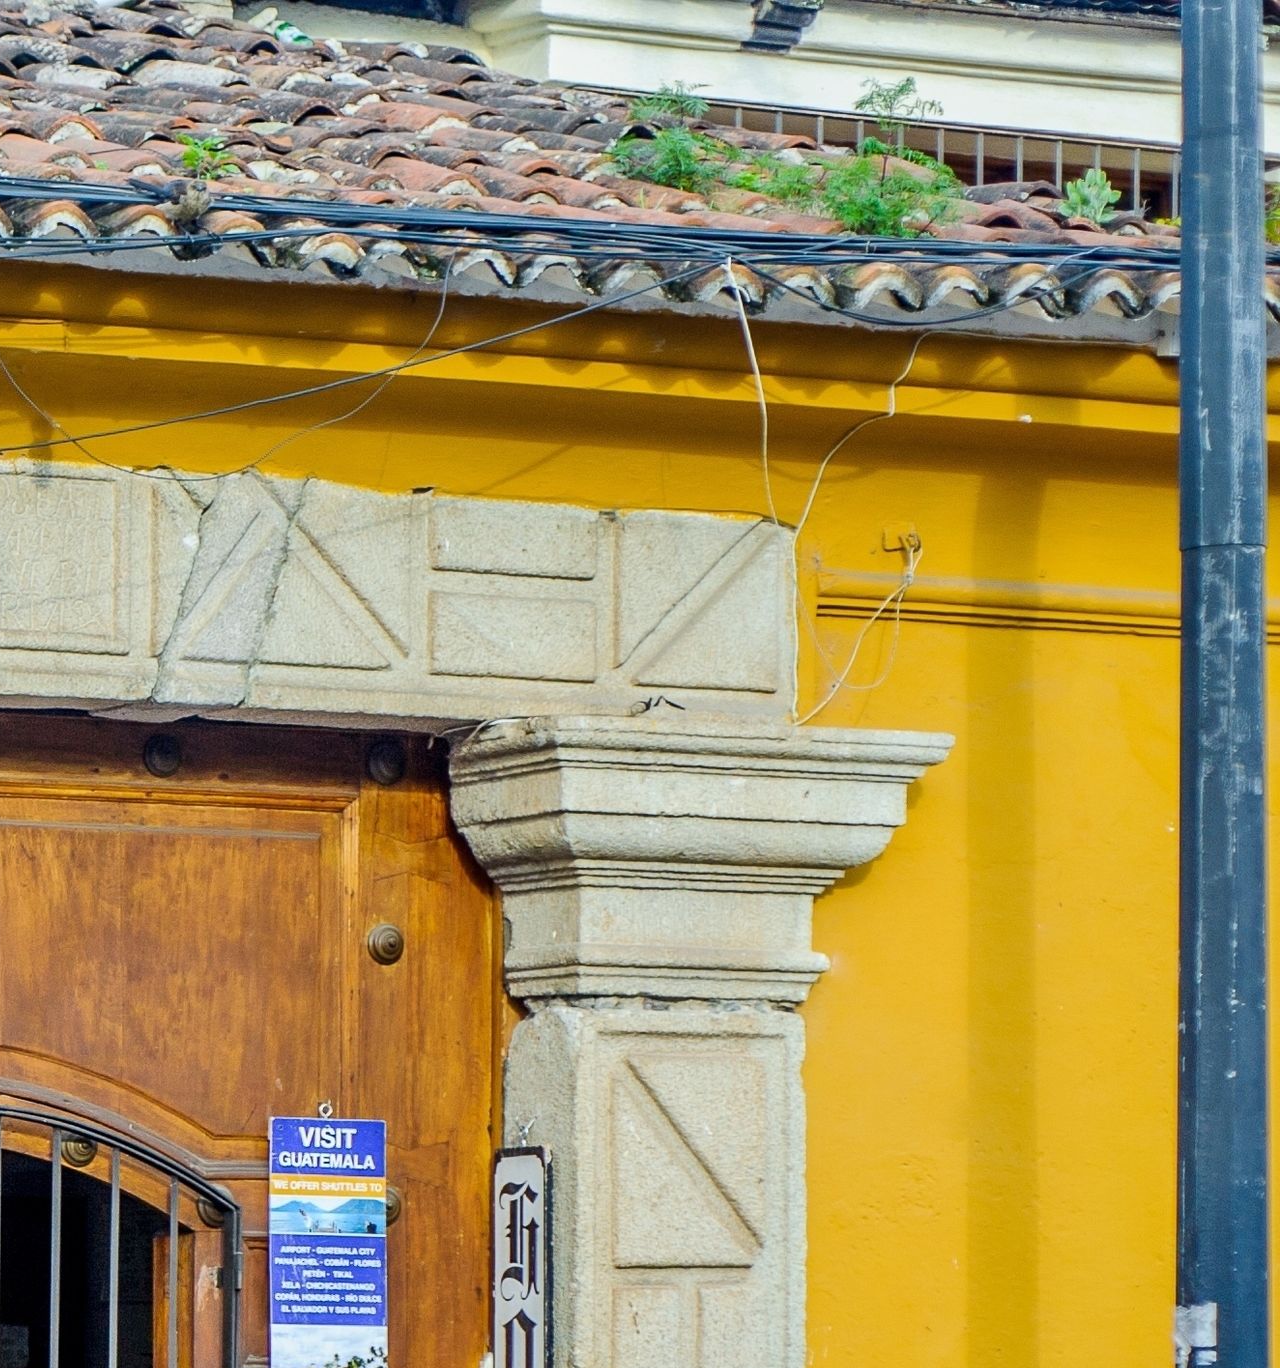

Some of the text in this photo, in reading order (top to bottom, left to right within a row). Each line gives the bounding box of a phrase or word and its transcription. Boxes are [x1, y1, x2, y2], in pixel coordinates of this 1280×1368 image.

[299, 1126, 357, 1149] VISIT
[279, 1152, 375, 1170] GUATEMALA
[274, 1180, 382, 1192] WE OFFER SHUTTLES TO
